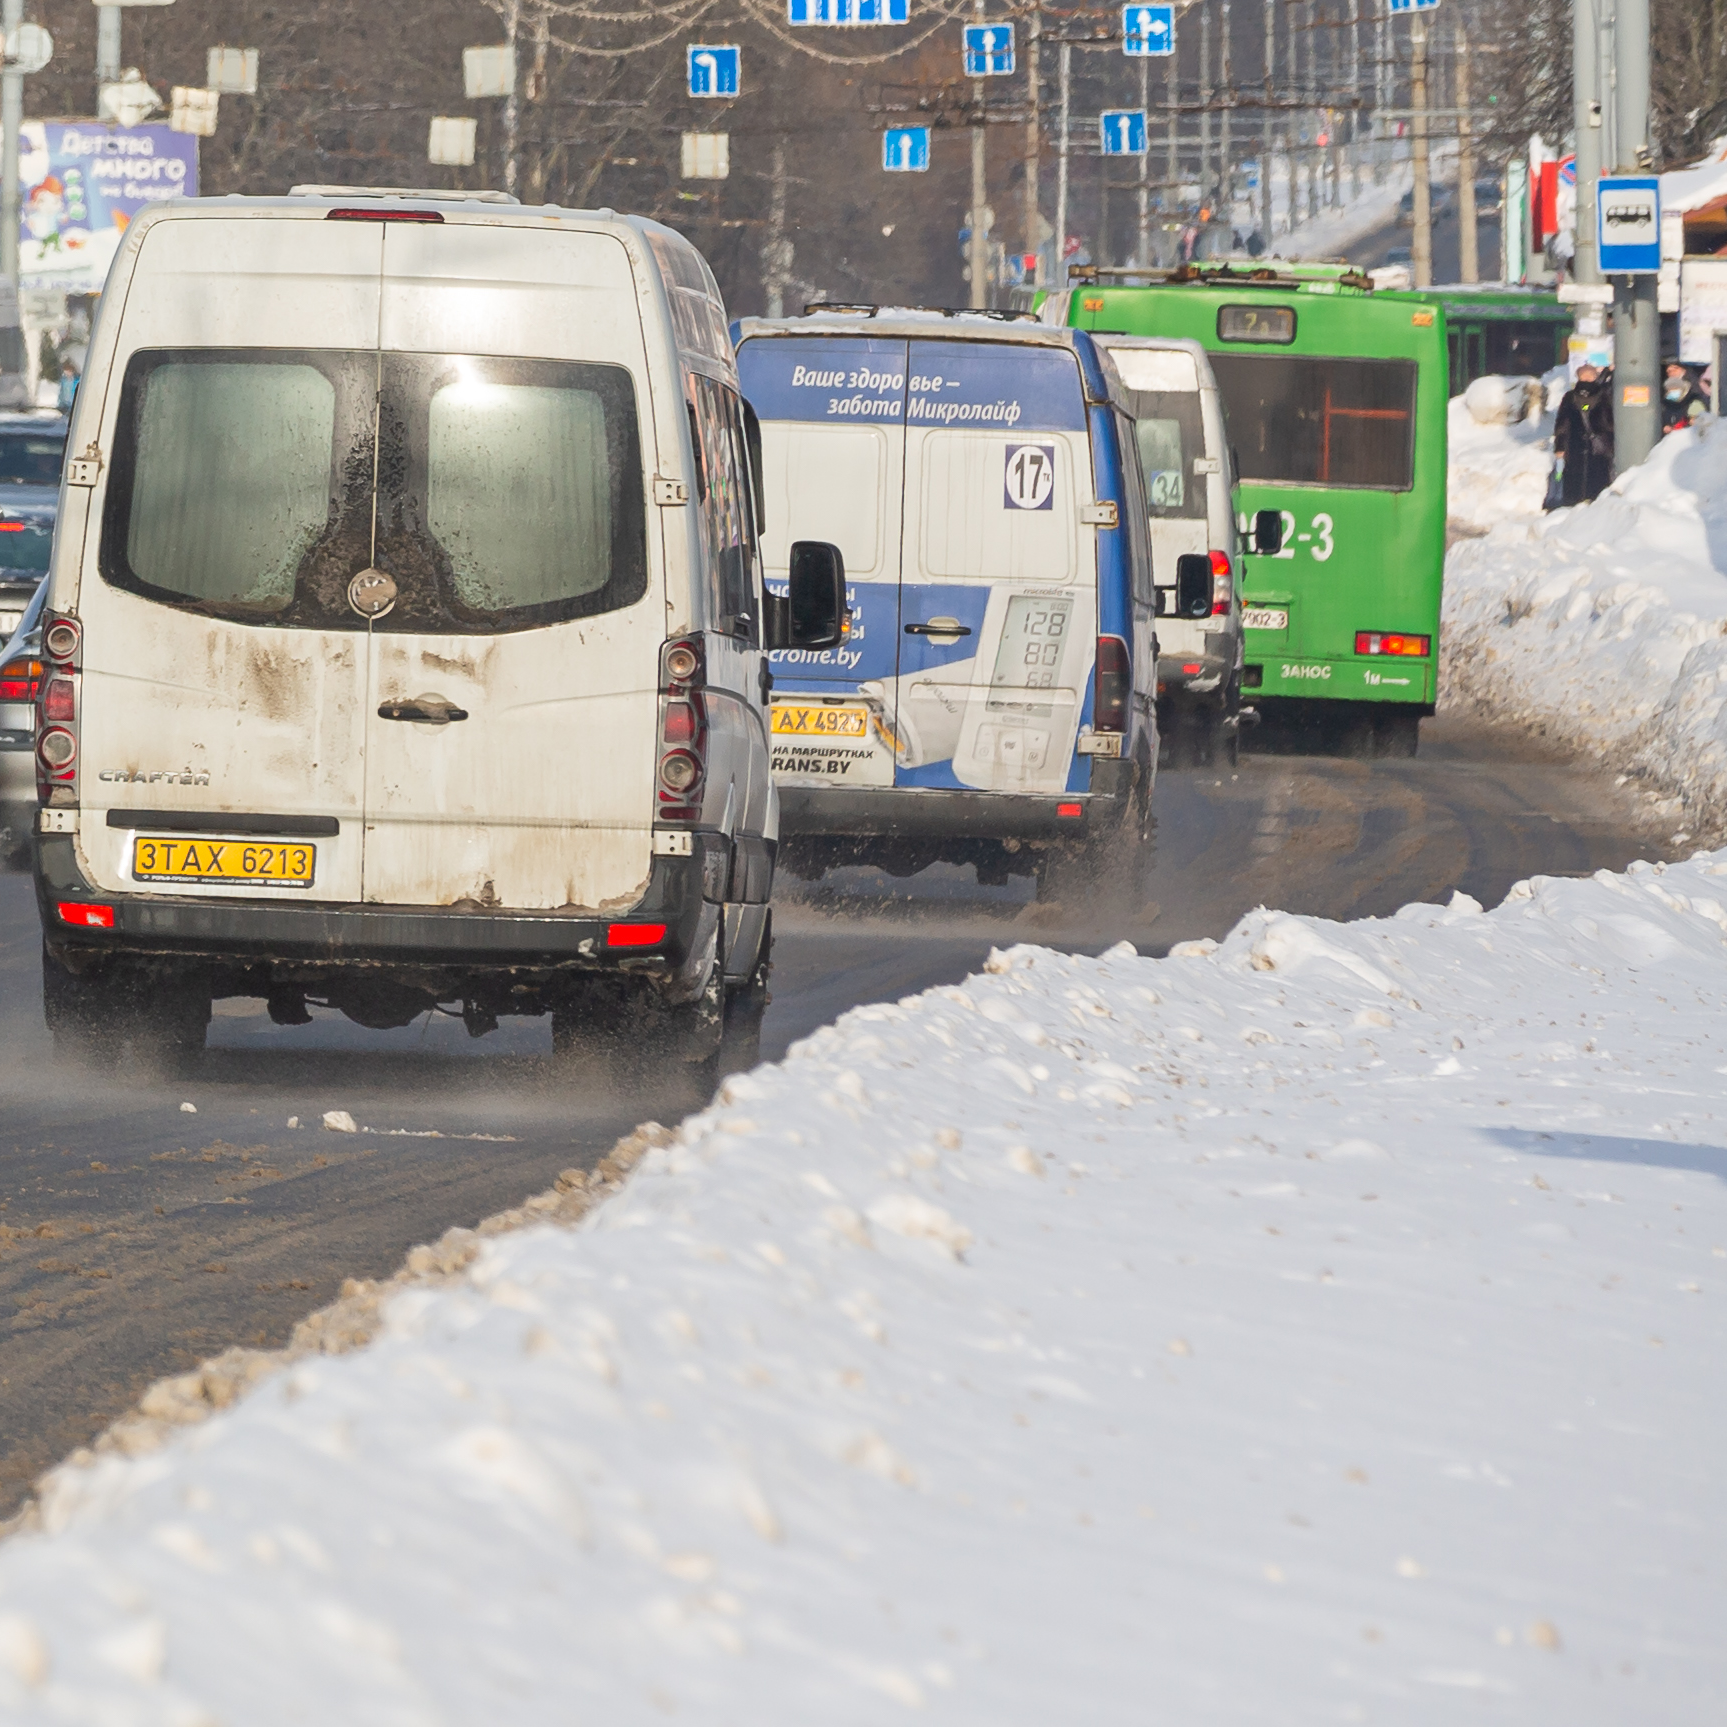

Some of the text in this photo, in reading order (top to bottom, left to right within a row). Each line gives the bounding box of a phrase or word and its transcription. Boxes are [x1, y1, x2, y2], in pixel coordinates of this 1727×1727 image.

[792, 365, 844, 388] Ваше
[827, 394, 1021, 426] забота Микролайф
[1014, 453, 1043, 500] 17
[1156, 475, 1182, 506] 34
[1024, 612, 1066, 637] 128
[1024, 642, 1060, 666] 80
[1281, 664, 1331, 679] ЗАНОС
[791, 747, 874, 759] МАРШРУТКАХ
[98, 768, 210, 786] CRAFTER
[141, 843, 307, 876] 3TAX 6213
